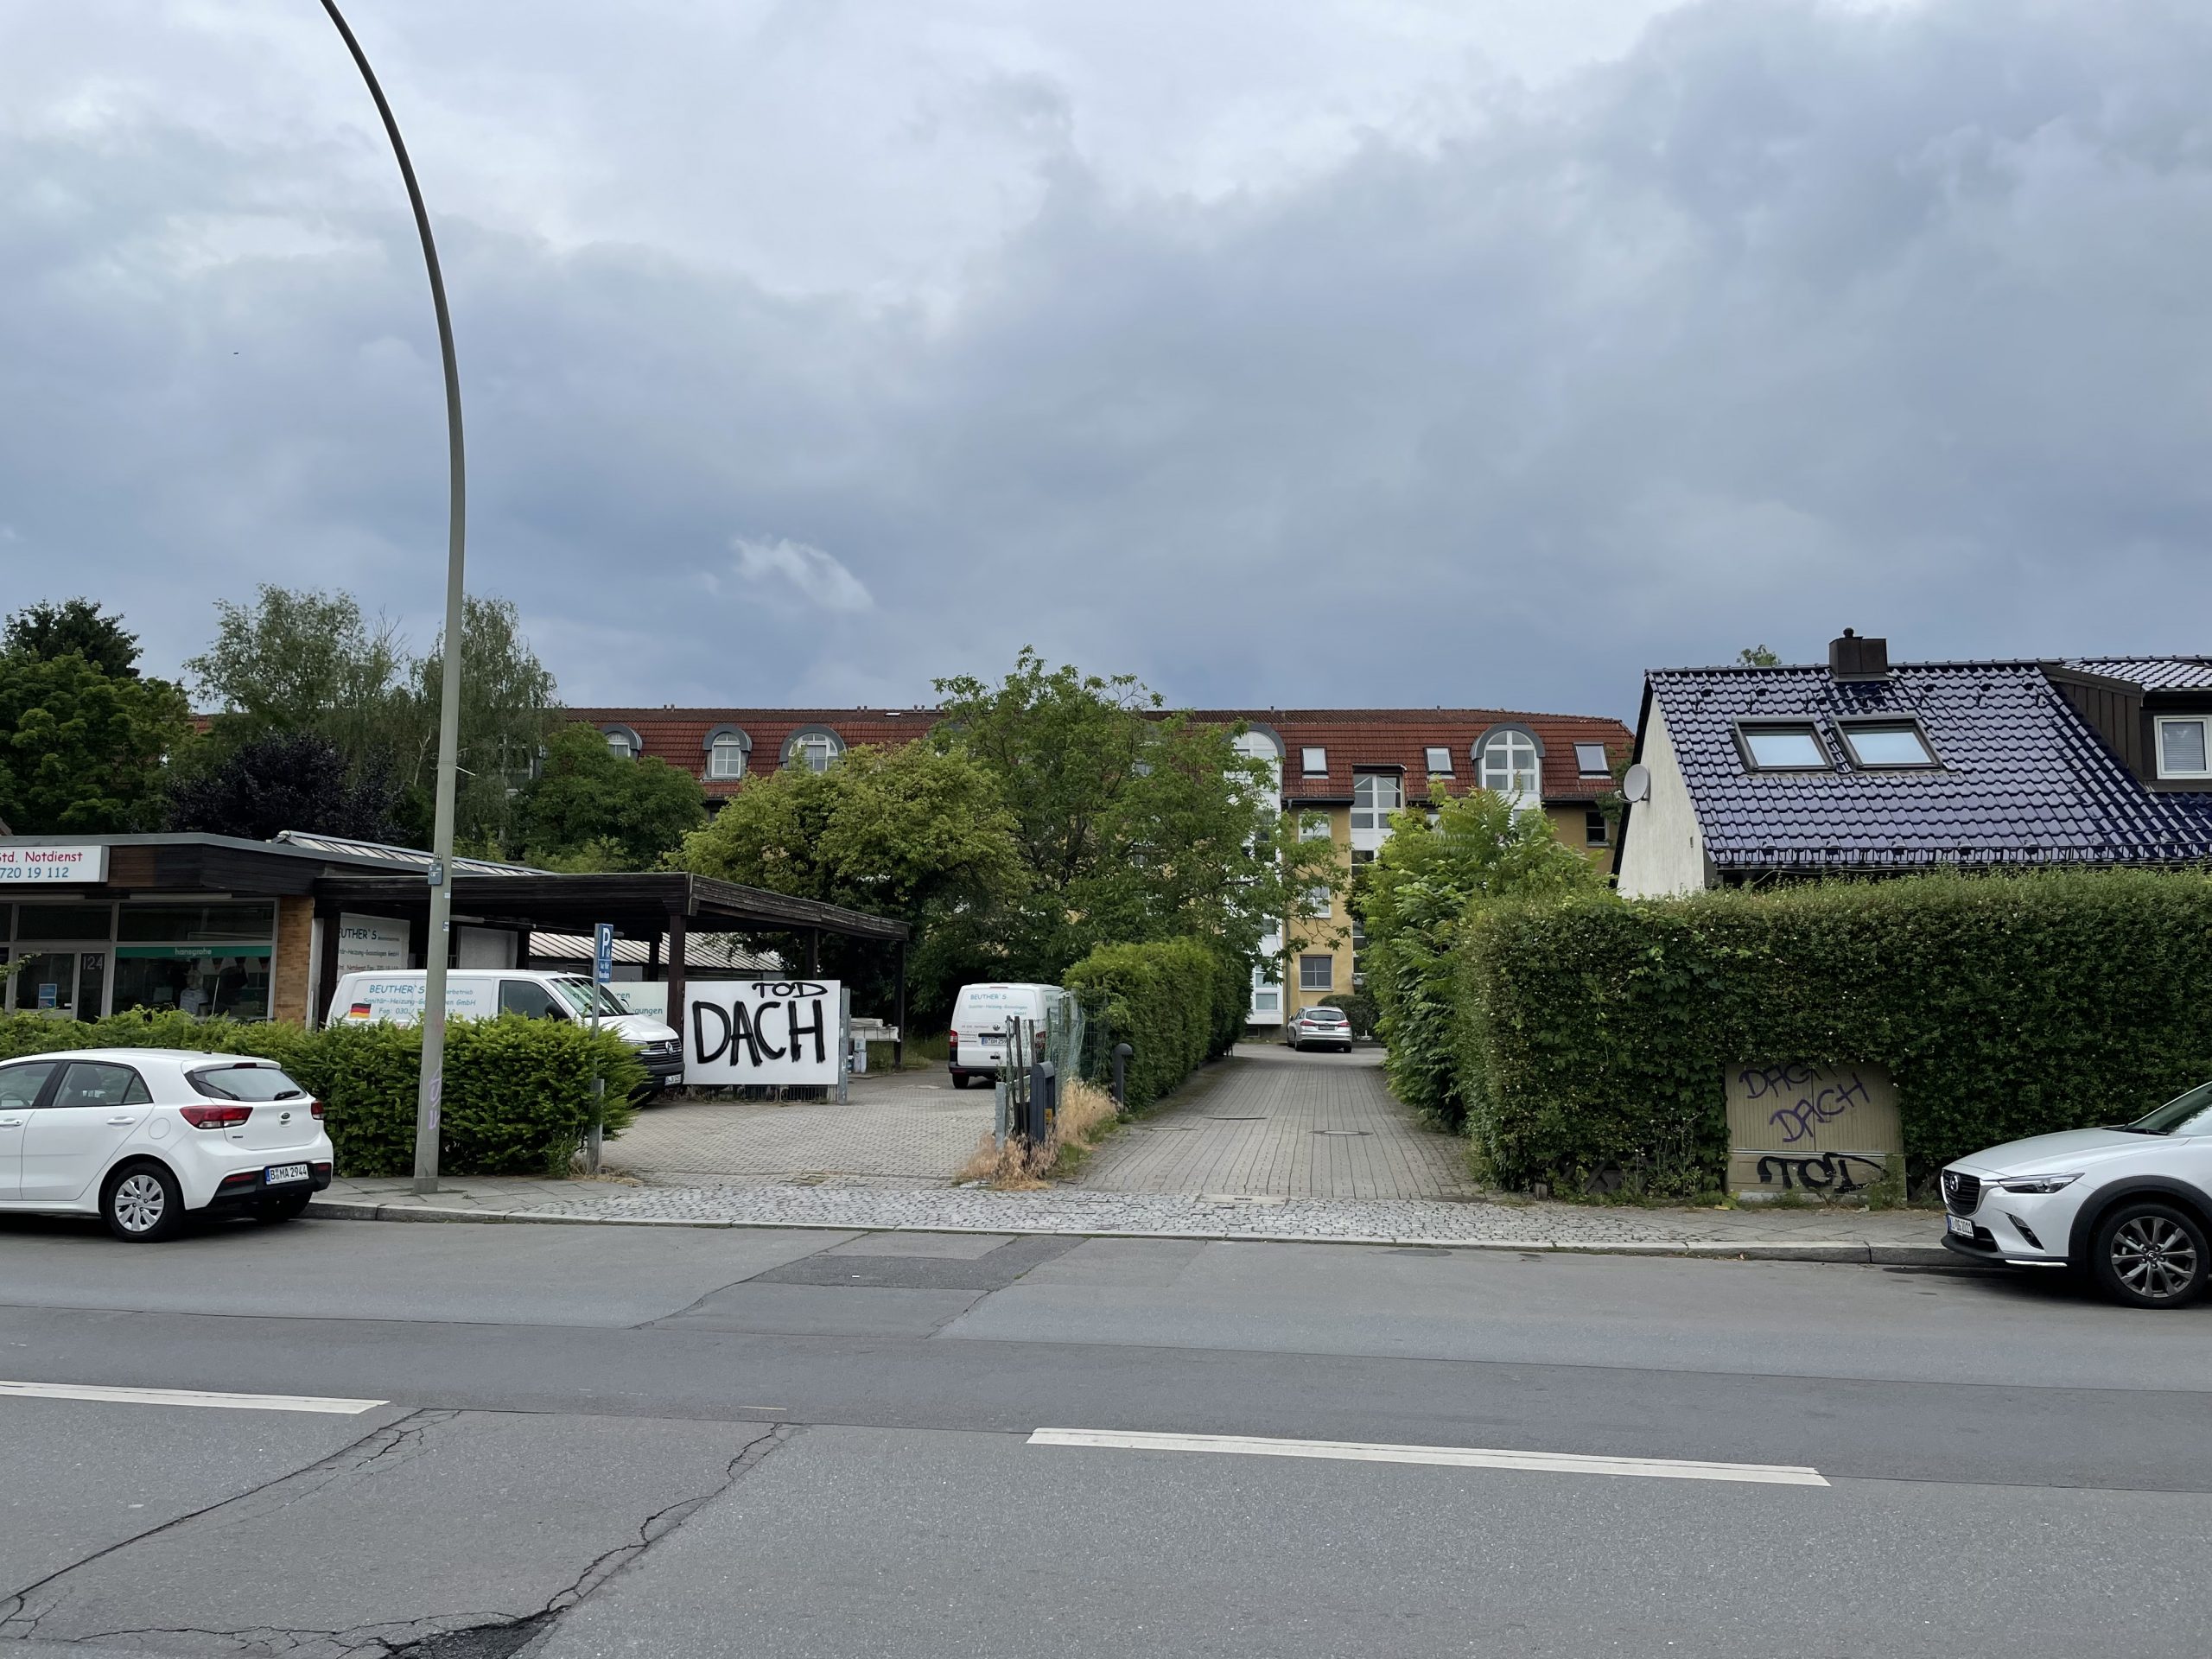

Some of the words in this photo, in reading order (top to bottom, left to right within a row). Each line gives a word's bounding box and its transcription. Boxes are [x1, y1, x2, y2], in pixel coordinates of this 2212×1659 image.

[25, 851, 83, 862] Notdienst
[0, 868, 22, 879] 720
[28, 868, 41, 879] 19
[48, 867, 69, 878] 112
[602, 928, 611, 957] P
[175, 948, 212, 957] hansgrohe
[83, 956, 103, 970] 124
[752, 982, 828, 998] TOD
[692, 999, 826, 1068] DACH
[1770, 1071, 1870, 1142] DACH
[270, 1170, 276, 1179] B
[280, 1168, 289, 1179] MA
[290, 1166, 307, 1177] 2944
[1758, 1152, 1890, 1194] TOD
